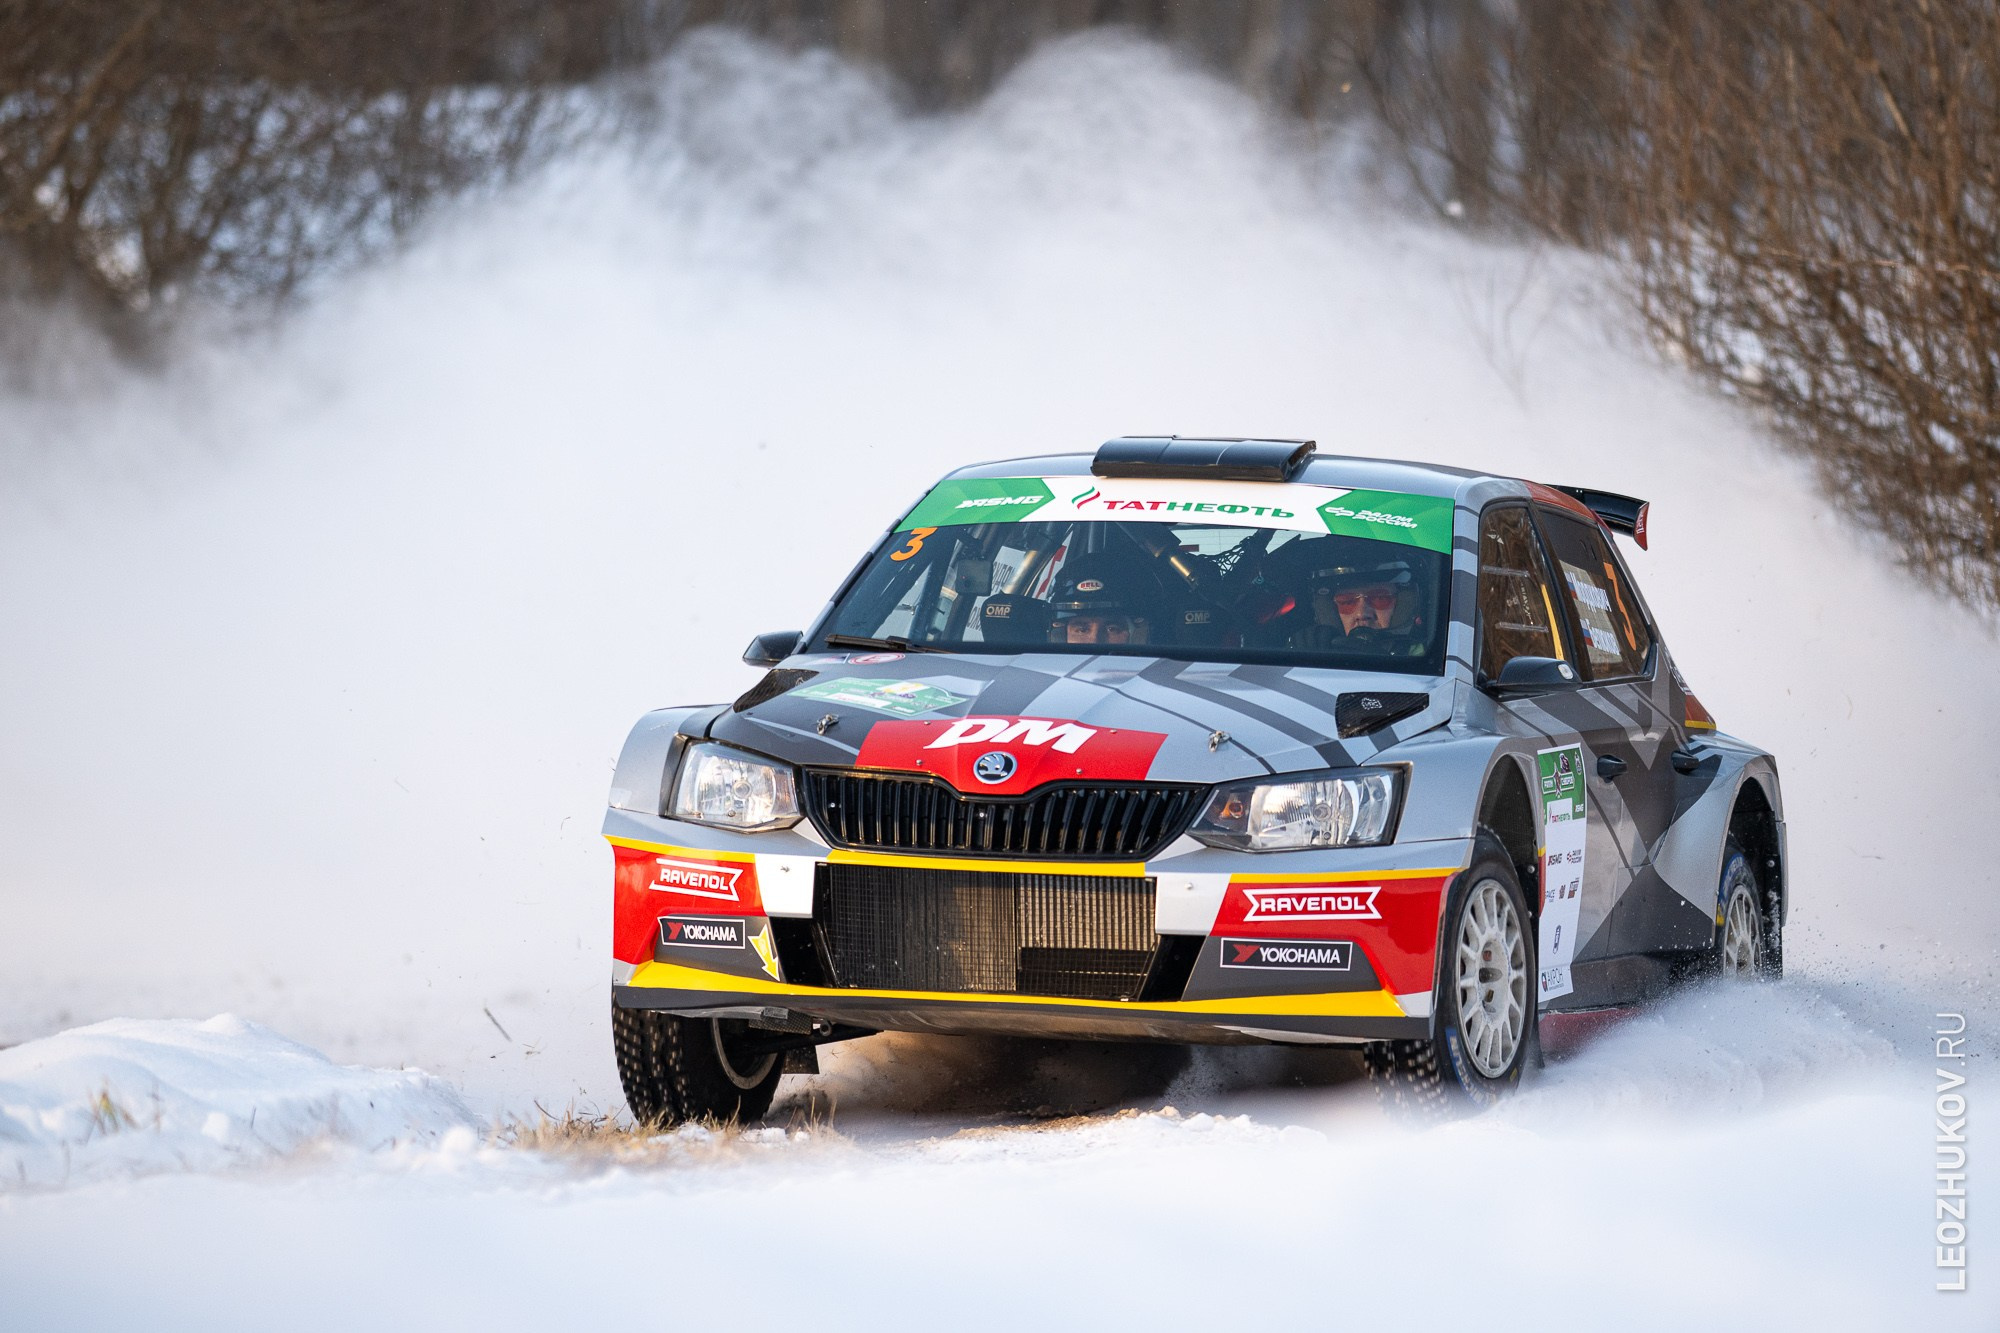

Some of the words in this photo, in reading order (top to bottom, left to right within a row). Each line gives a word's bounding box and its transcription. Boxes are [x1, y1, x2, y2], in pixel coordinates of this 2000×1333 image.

[1103, 500, 1295, 518] ТАТНЕФТЬ
[1352, 514, 1418, 529] РОССИИ
[890, 527, 938, 561] 3
[986, 605, 1011, 616] OMP
[1185, 612, 1210, 622] OMP
[923, 718, 1098, 754] DM
[660, 868, 729, 891] RAVENOL
[1260, 896, 1367, 912] RAVENOL
[683, 924, 738, 942] YOKOHAMA
[1259, 946, 1341, 964] YOKOHAMA
